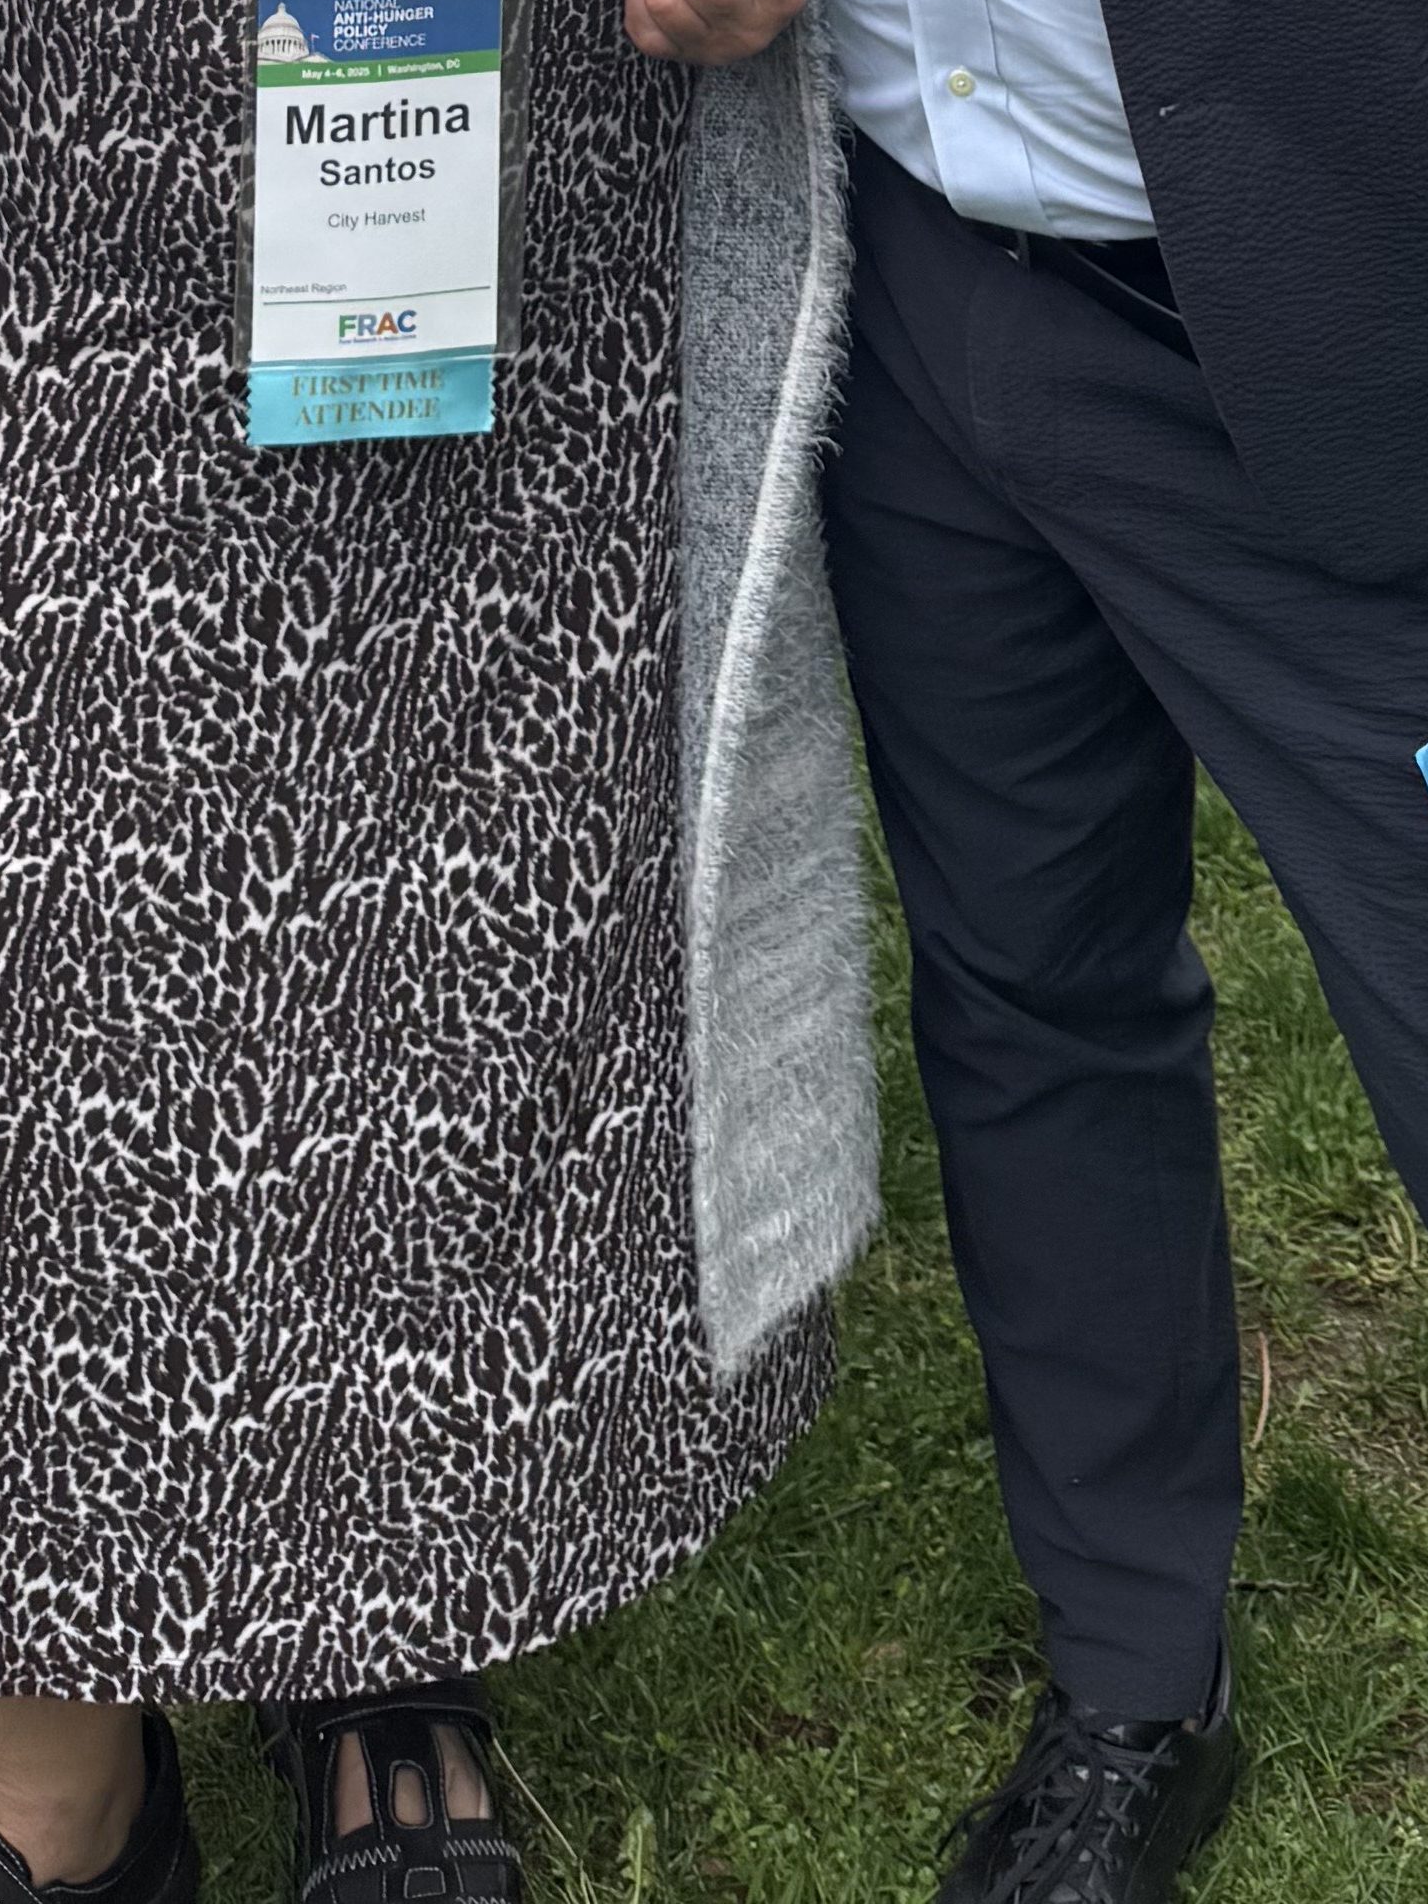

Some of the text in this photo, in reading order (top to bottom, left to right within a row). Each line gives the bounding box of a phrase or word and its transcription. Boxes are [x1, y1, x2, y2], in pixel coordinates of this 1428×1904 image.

[334, 7, 434, 25] ANTI-HUNGER
[334, 24, 388, 38] POLICY
[334, 33, 426, 52] CONFERENCE
[302, 69, 322, 80] May
[446, 58, 461, 70] DC
[286, 98, 470, 144] Martina
[320, 157, 435, 186] Santos
[328, 208, 425, 230] City Harvest
[261, 282, 347, 295] Northeast Region
[339, 309, 417, 337] FRAC
[293, 368, 445, 396] FIRST TIME
[296, 397, 440, 426] ATTENDEE
